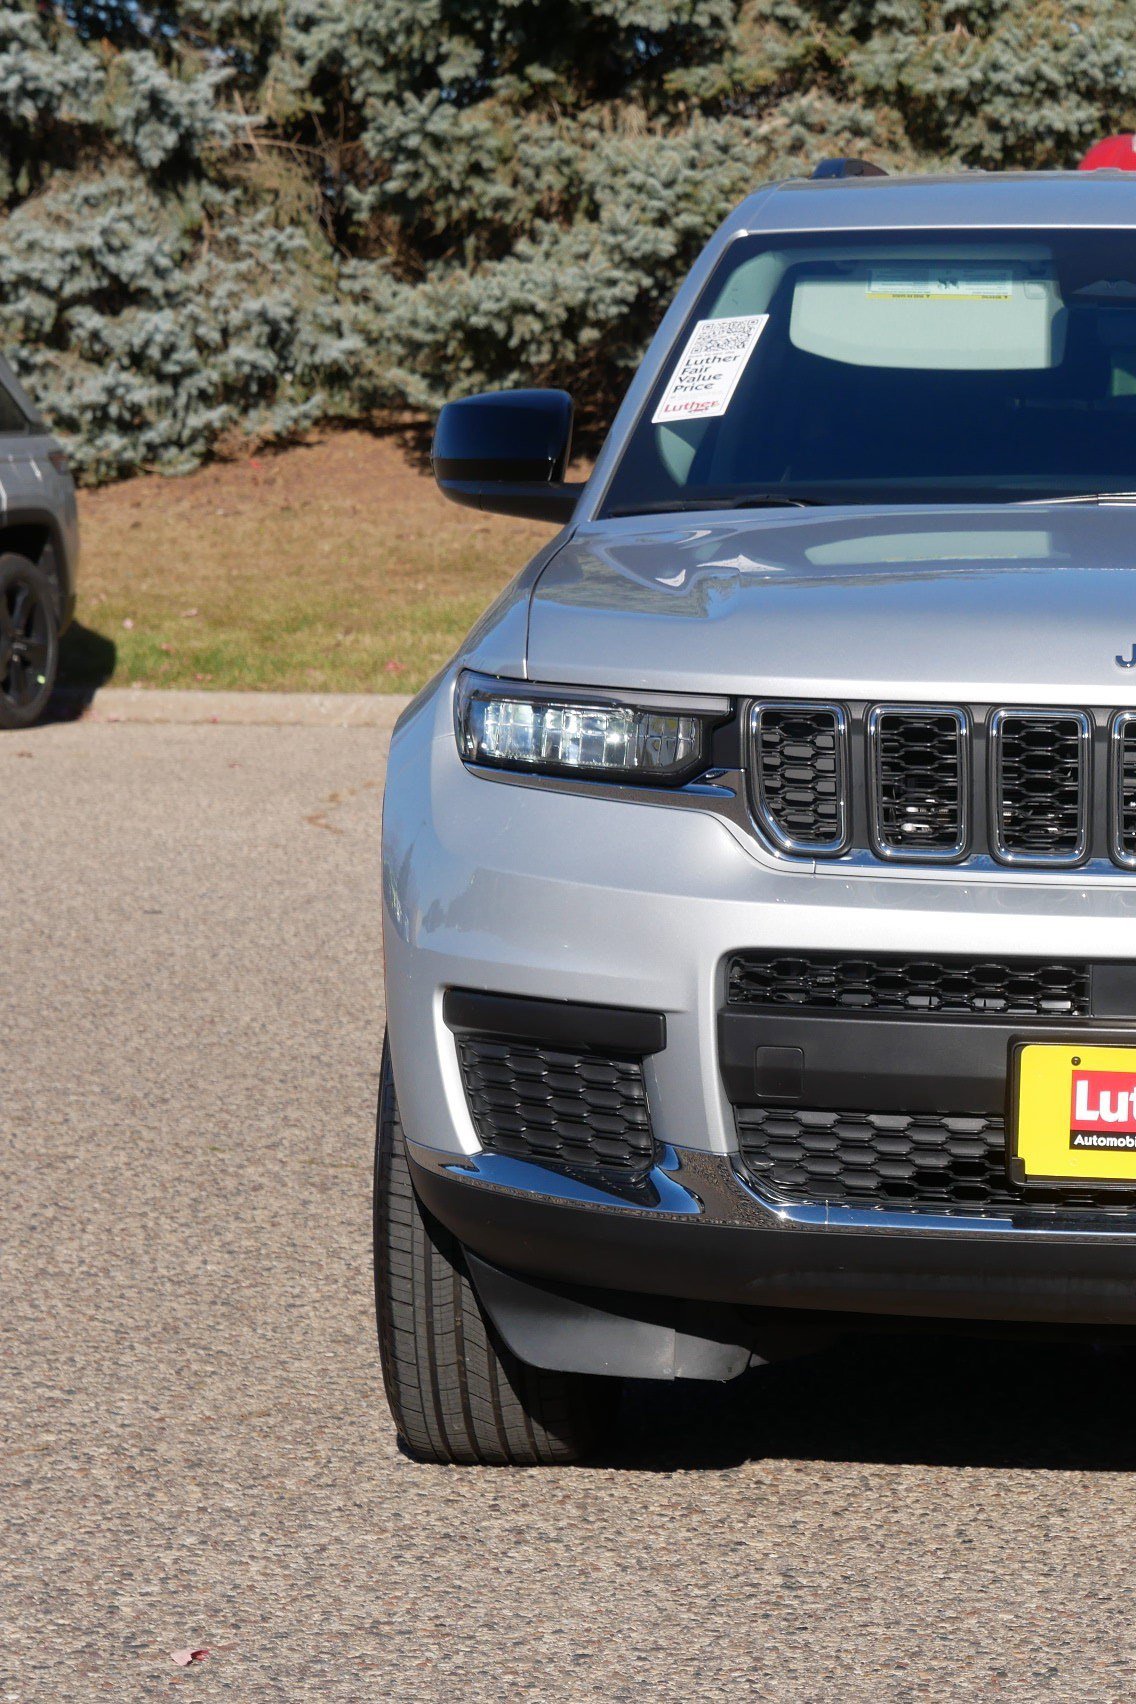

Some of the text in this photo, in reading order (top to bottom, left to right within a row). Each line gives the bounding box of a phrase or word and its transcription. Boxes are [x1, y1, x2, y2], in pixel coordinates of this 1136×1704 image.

[685, 354, 740, 366] Luther
[681, 366, 711, 375] Fair
[678, 373, 722, 383] Value
[673, 383, 713, 393] Price
[664, 401, 720, 412] Luther
